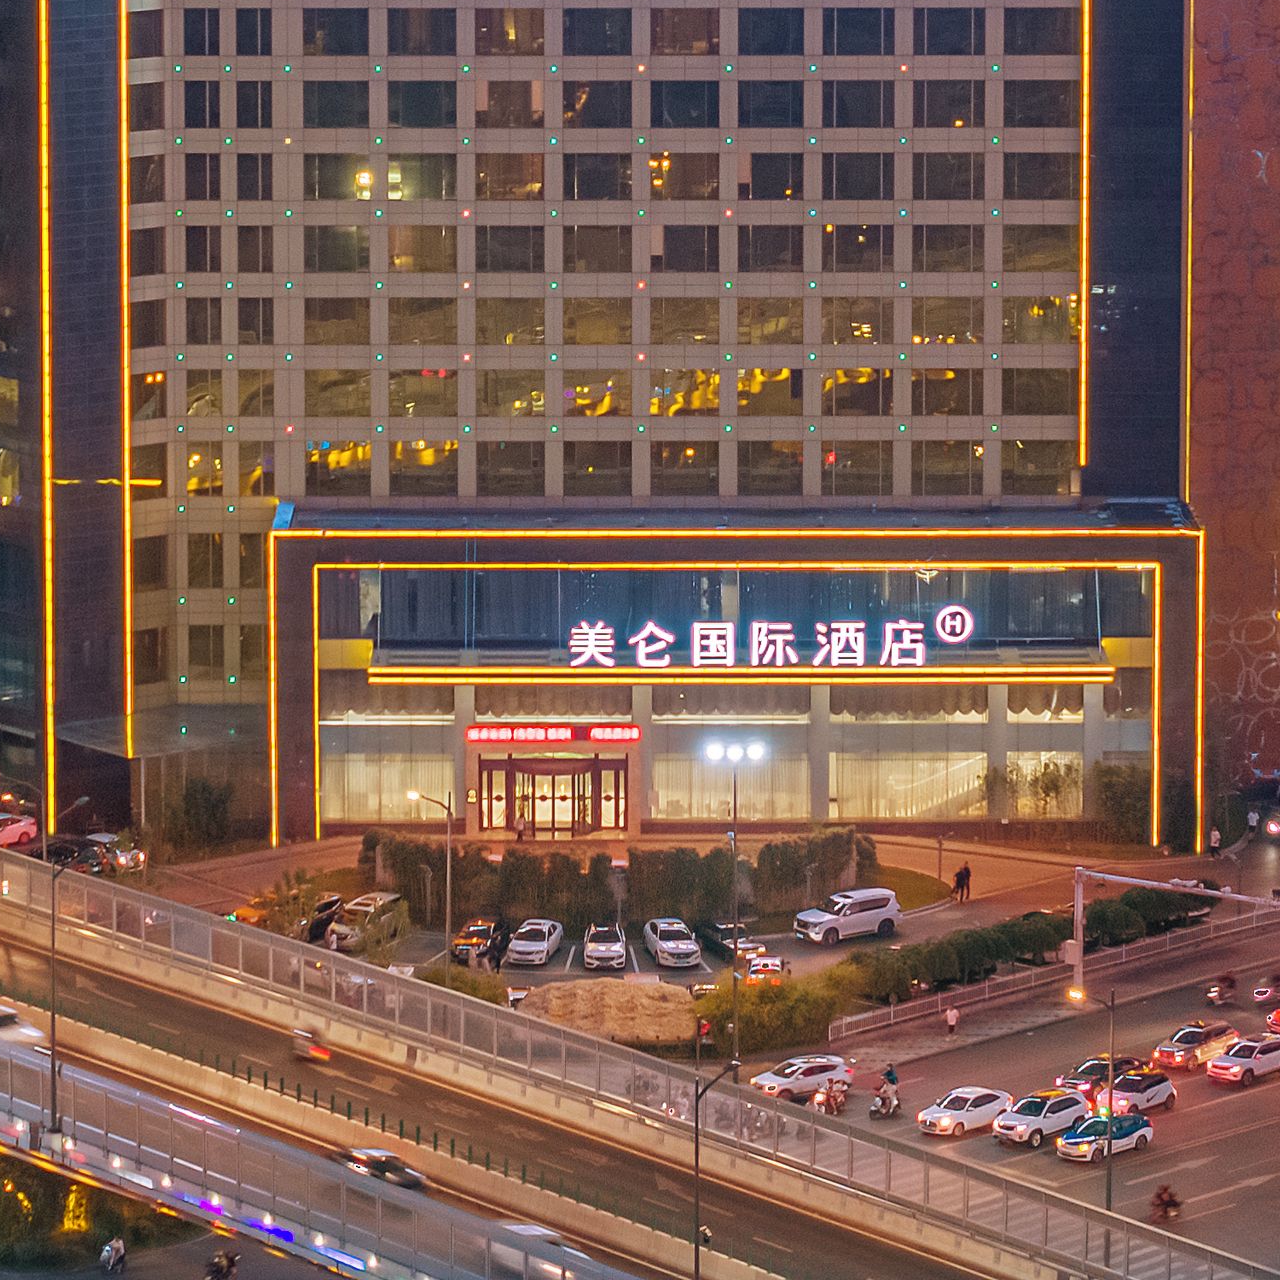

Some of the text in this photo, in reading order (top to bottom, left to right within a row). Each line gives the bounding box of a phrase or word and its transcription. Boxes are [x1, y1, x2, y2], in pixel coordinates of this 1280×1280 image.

[569, 619, 926, 668] 美仑国际酒店
